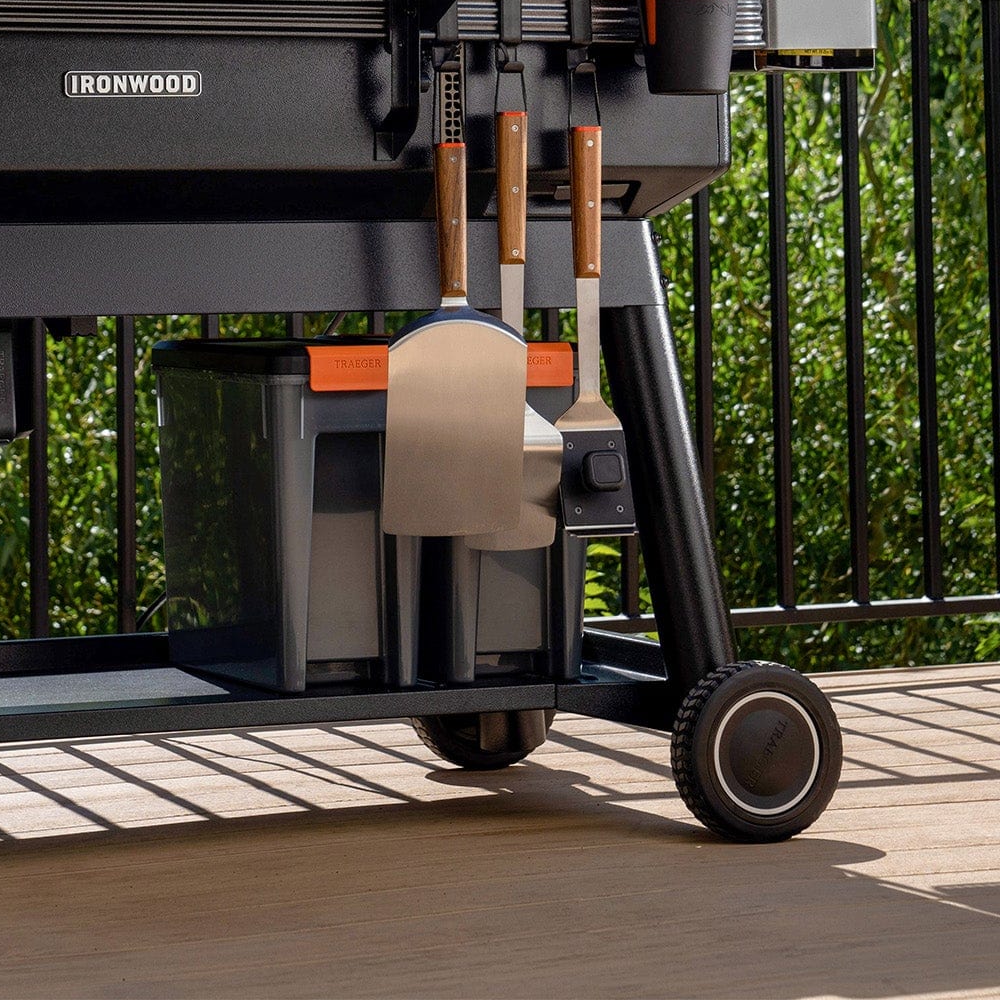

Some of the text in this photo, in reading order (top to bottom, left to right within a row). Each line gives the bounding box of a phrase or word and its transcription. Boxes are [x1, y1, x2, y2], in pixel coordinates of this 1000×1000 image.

[71, 74, 197, 94] IRONWOOD
[334, 359, 382, 369] TRAEGER
[527, 356, 552, 365] EGER
